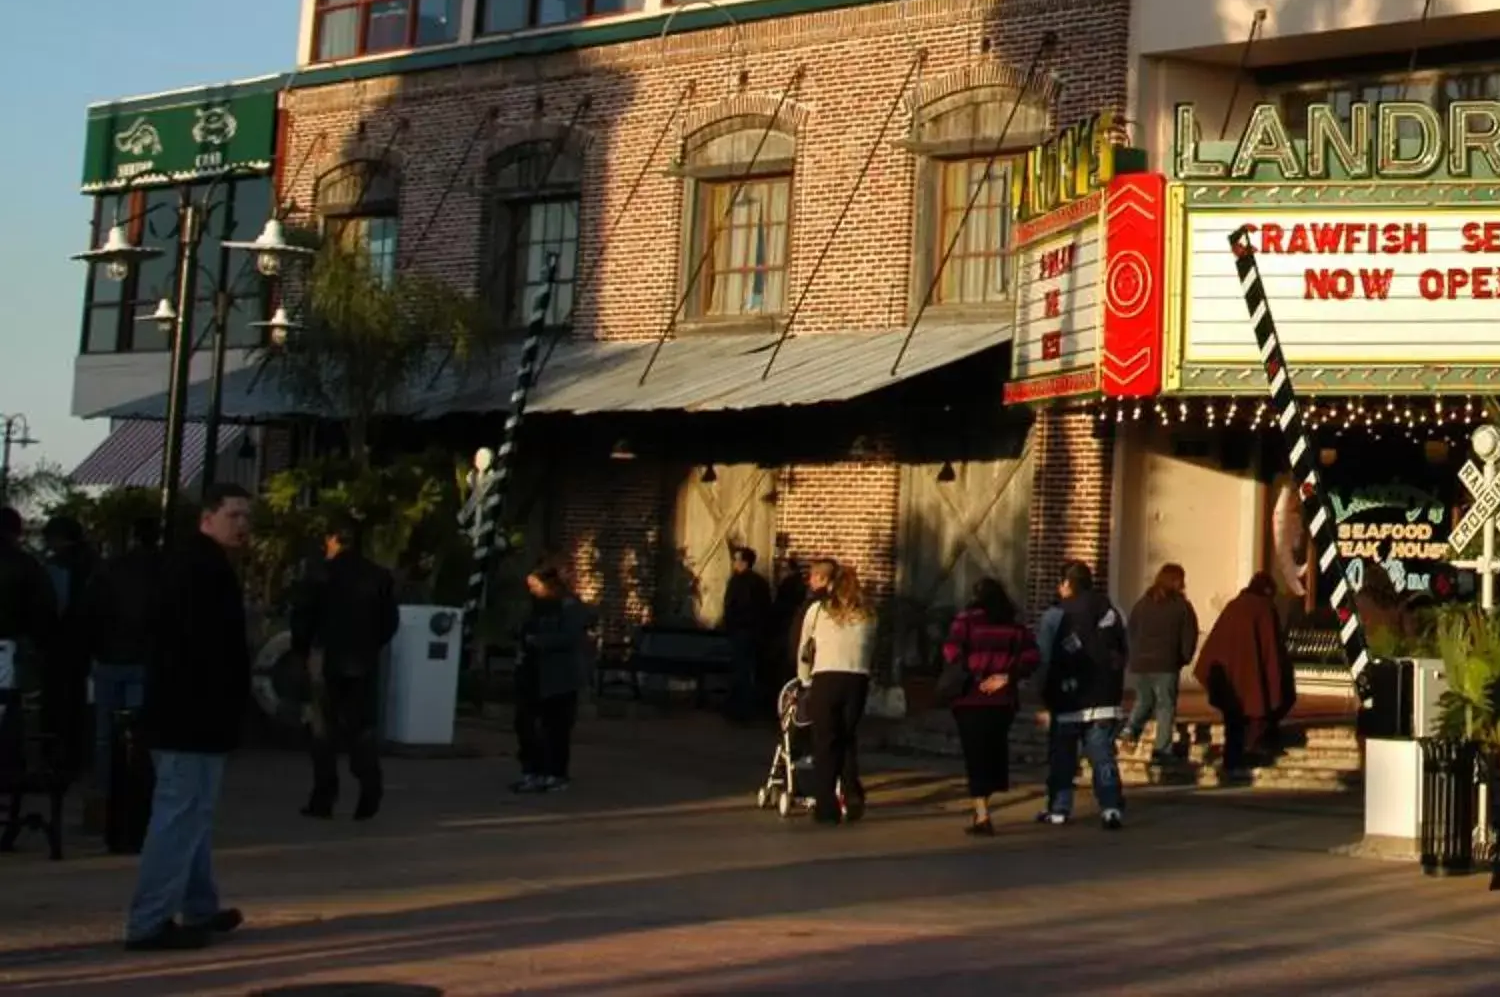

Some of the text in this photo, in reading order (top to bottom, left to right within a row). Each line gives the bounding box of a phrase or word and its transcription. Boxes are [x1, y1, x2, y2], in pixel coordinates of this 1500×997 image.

[1303, 268, 1395, 301] NOW
[1337, 523, 1432, 540] SEAFOOD
[1337, 540, 1380, 561] TEAK
